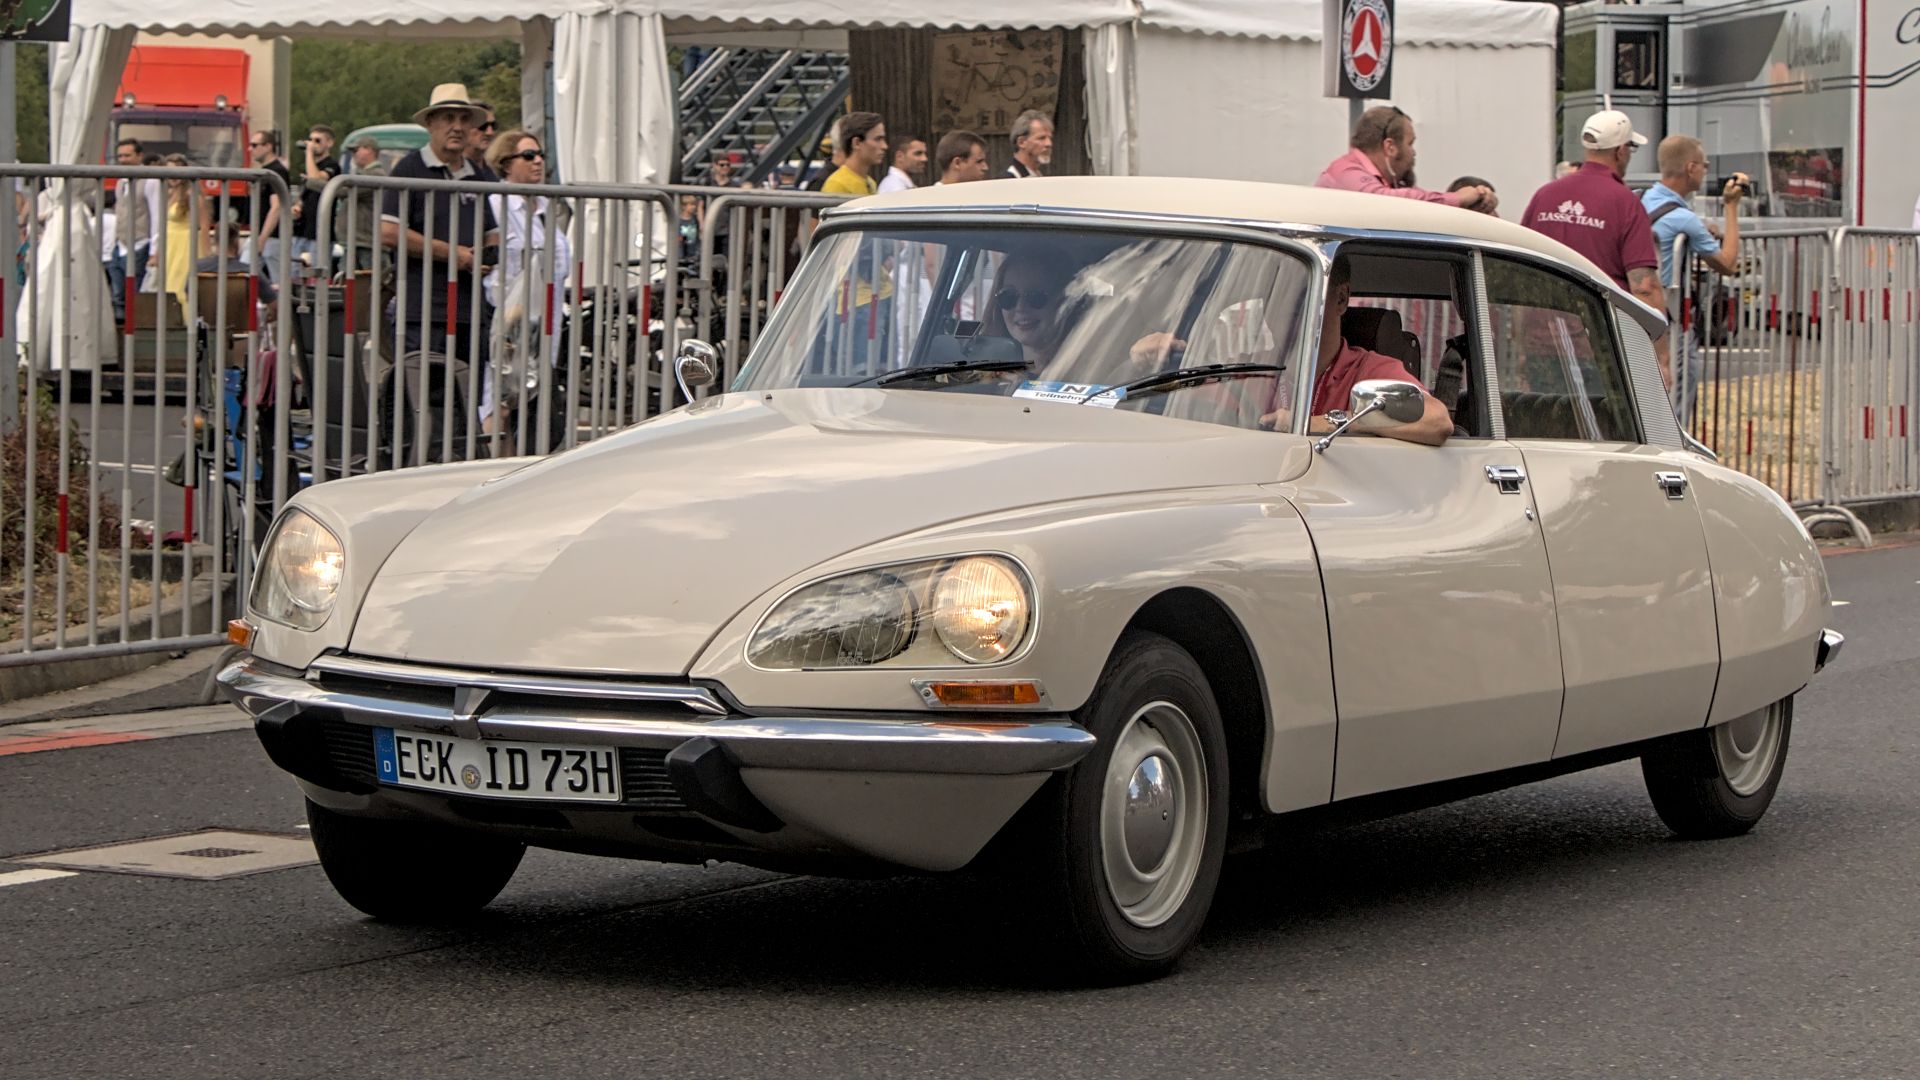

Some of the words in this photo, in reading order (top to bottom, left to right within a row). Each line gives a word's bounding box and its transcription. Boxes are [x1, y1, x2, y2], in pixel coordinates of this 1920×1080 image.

[1537, 211, 1574, 223] CLASSIC
[1575, 215, 1605, 229] TEAM
[1034, 391, 1098, 403] Teilnehmr
[1063, 385, 1087, 394] N
[383, 759, 392, 774] D
[396, 735, 456, 785] ECK
[486, 746, 529, 790] ID
[541, 749, 615, 794] 73H
